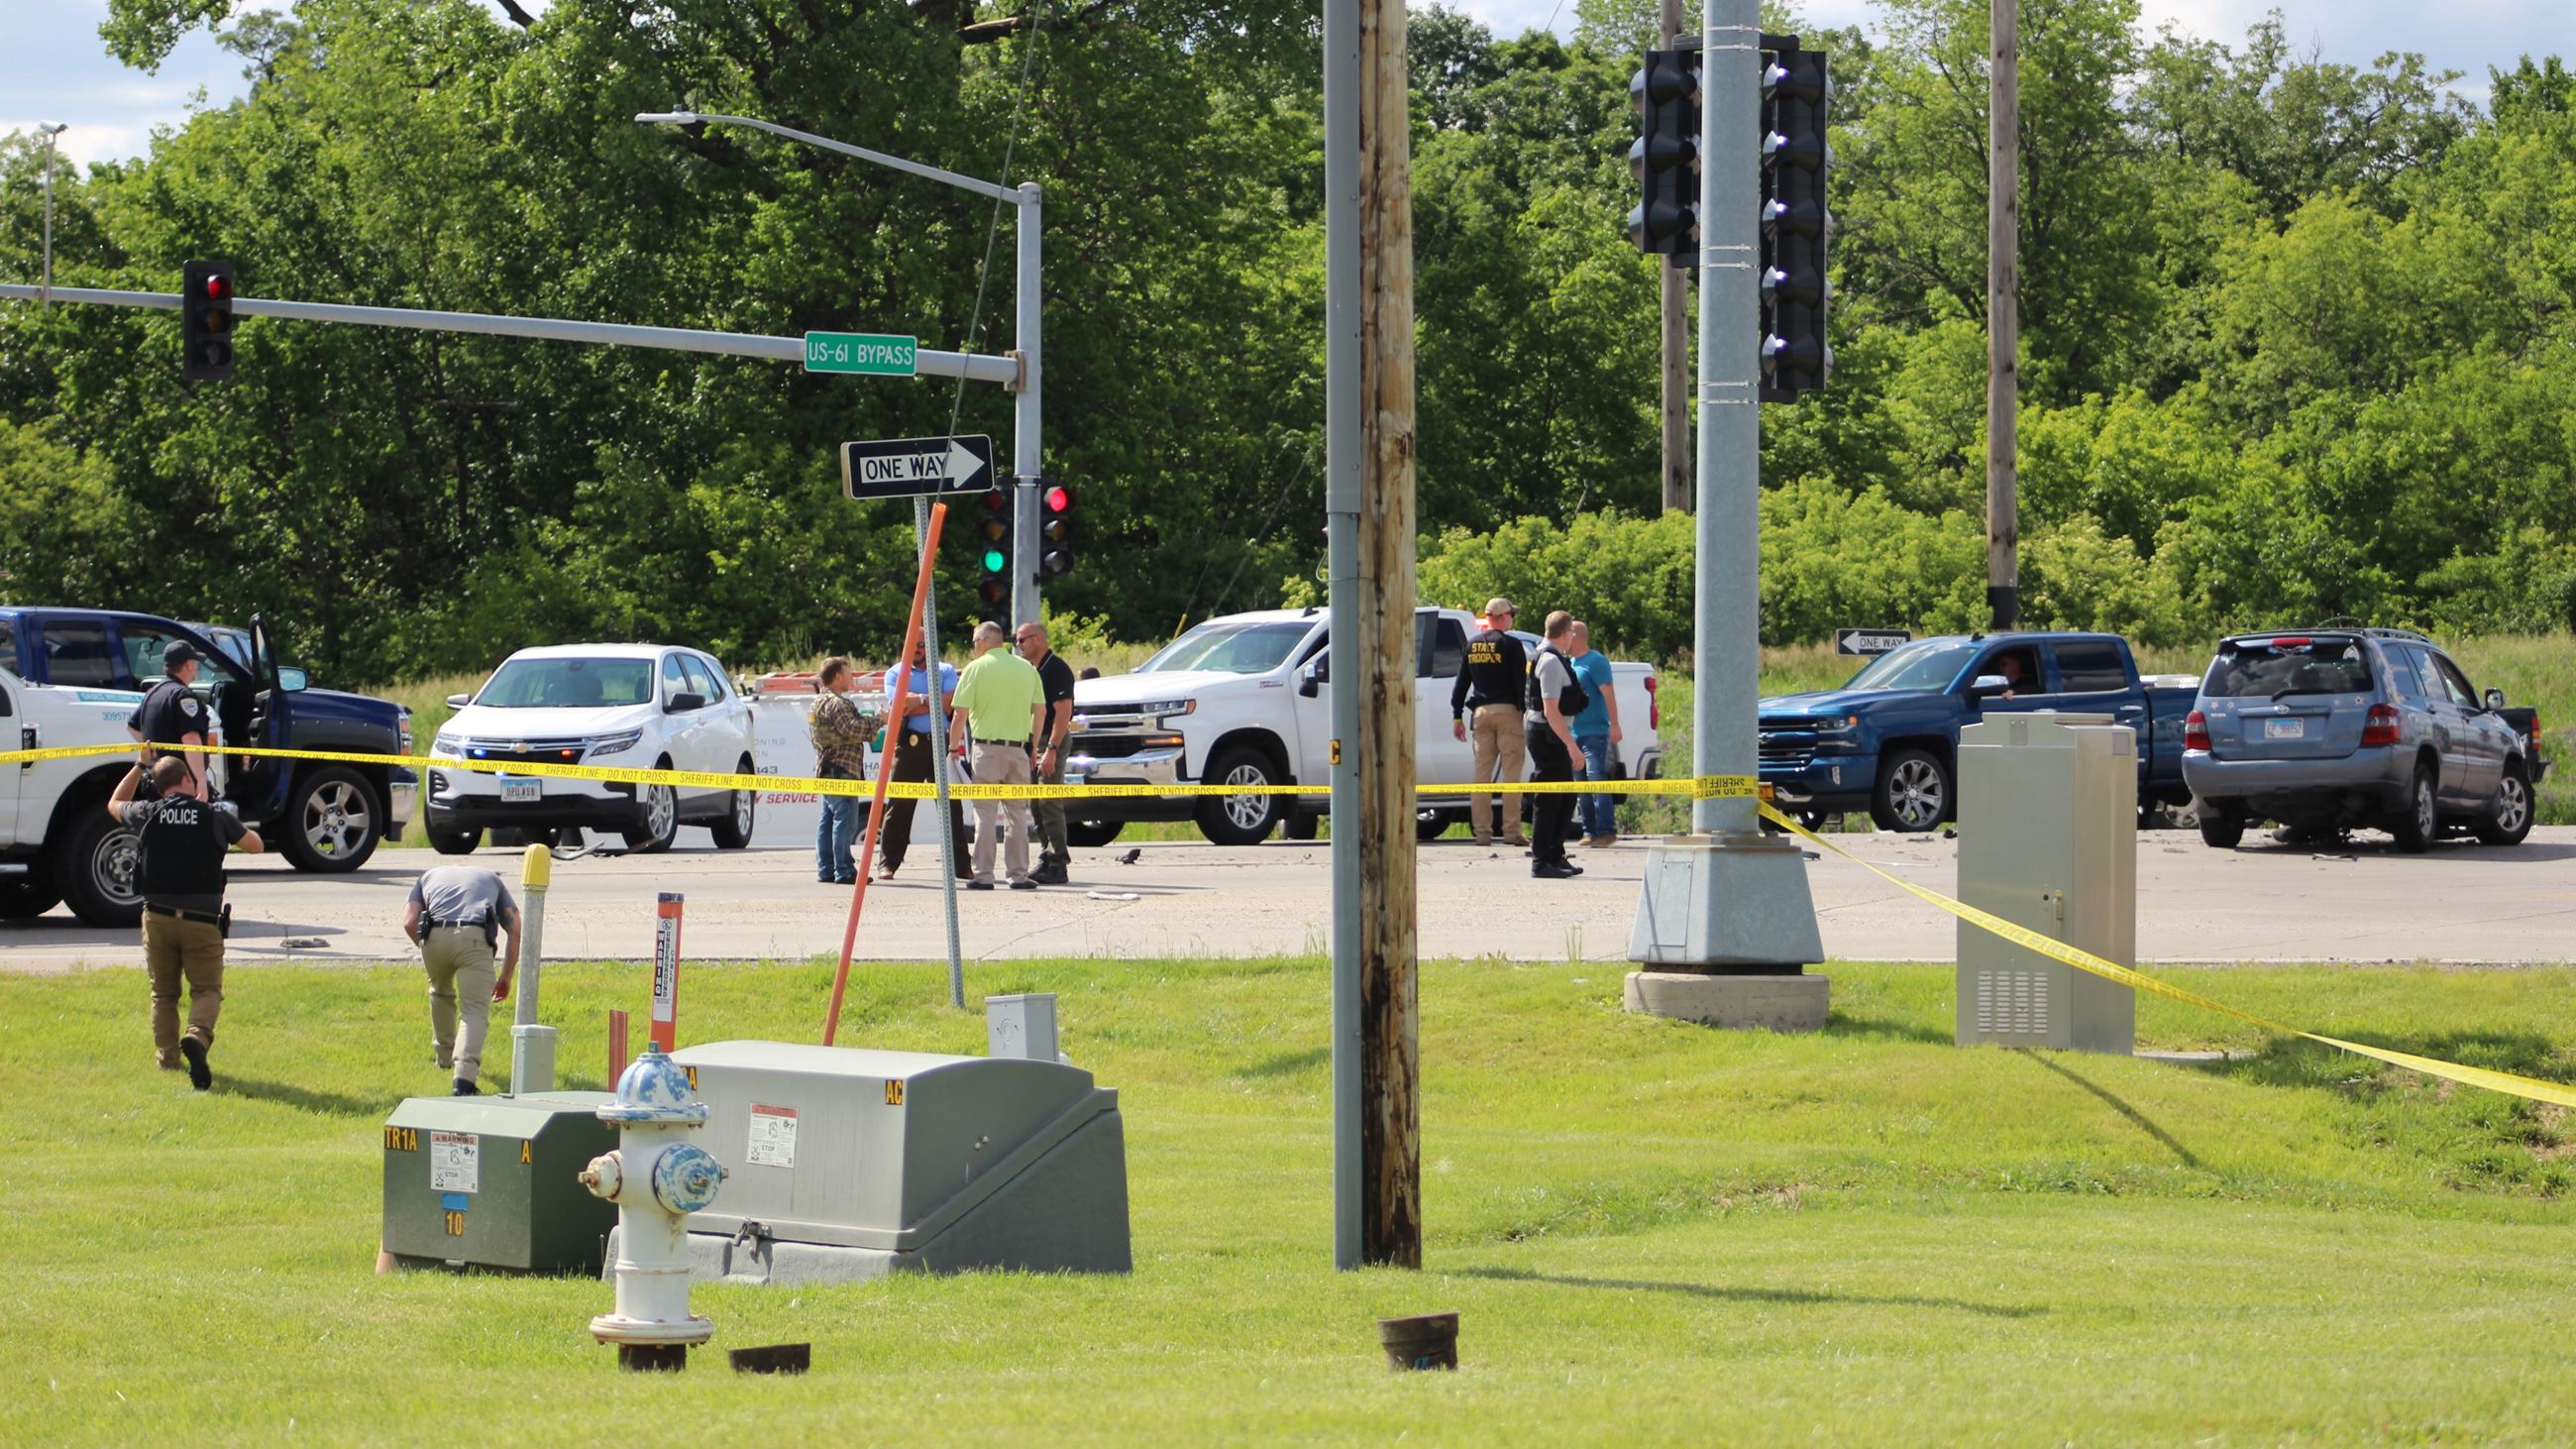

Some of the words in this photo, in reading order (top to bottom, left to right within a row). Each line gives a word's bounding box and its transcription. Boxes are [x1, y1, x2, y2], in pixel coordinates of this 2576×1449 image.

[808, 342, 848, 363] US-61
[857, 344, 912, 366] BYPASS
[866, 459, 904, 480] ONE
[910, 456, 947, 477] WAY
[1471, 642, 1496, 652] STATE
[1860, 637, 1878, 647] ONE
[1882, 638, 1902, 647] WAY
[1467, 653, 1502, 664] TROOPER
[1331, 740, 1340, 764] C
[471, 761, 484, 771] DO
[485, 762, 502, 772] NOT
[504, 763, 533, 774] CROSS
[545, 766, 580, 776] SHERIFF
[581, 768, 599, 778] LINE
[606, 769, 619, 780] DO
[621, 770, 638, 781] NOT
[640, 771, 668, 783] CROSS
[680, 773, 713, 785] SHERIFF
[715, 775, 734, 786] LINE
[741, 776, 754, 787] DO
[755, 778, 773, 789] NOT
[775, 779, 802, 790] CROSS
[813, 780, 847, 792] SHERIFF
[849, 781, 867, 793] LINE
[888, 784, 905, 795] NOT
[907, 784, 934, 797] CROSS
[767, 793, 817, 804] SERVICE
[947, 786, 982, 797] SHERIFF
[984, 786, 1003, 797] LINE
[1012, 786, 1023, 797] DO
[1025, 786, 1043, 797] NOT
[1046, 786, 1076, 797] CROSS
[1087, 786, 1123, 796] SHERIFF
[1126, 787, 1144, 796] LINE
[1153, 787, 1166, 796] DO
[160, 808, 198, 825] POLICE
[655, 931, 665, 996] WARNING
[886, 1080, 903, 1105] AC
[384, 1125, 417, 1151] TR1A
[442, 1135, 475, 1145] WARNING
[521, 1140, 531, 1164] A
[446, 1211, 463, 1236] 10
